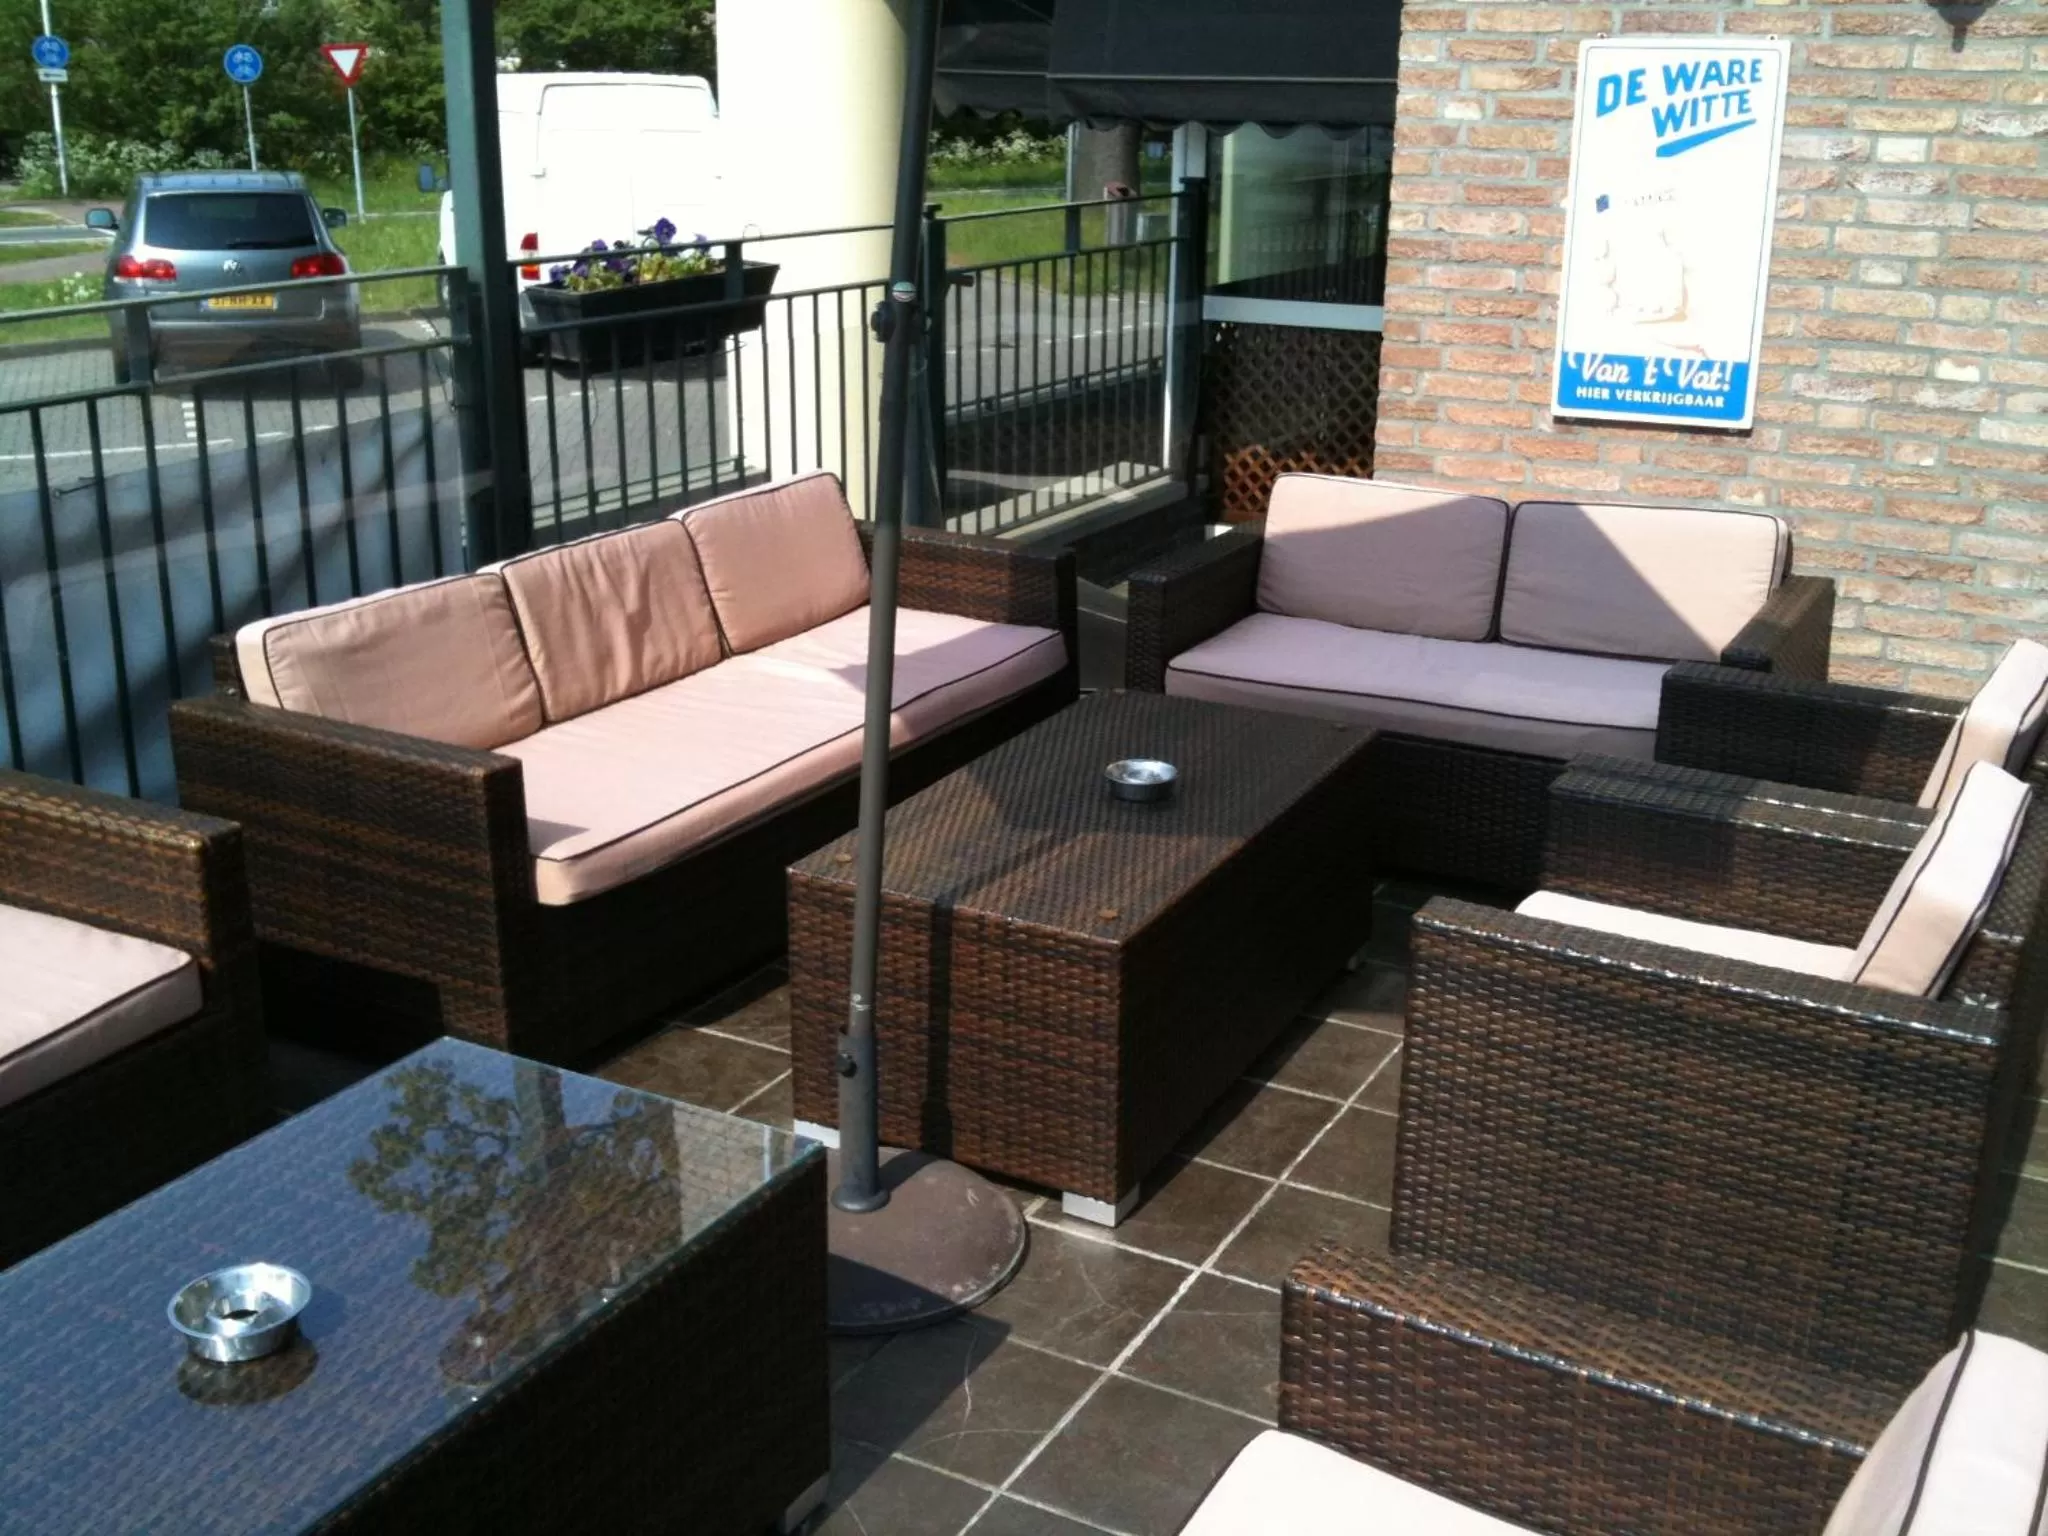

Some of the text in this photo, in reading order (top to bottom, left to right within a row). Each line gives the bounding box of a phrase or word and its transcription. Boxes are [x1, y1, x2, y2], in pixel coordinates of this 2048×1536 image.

[1596, 57, 1763, 119] DE WARE
[1651, 89, 1752, 138] WITTE
[1566, 348, 1631, 384] Van
[1662, 354, 1734, 392] Vat!
[1575, 385, 1725, 409] HIER VERKRIJGBAAR
